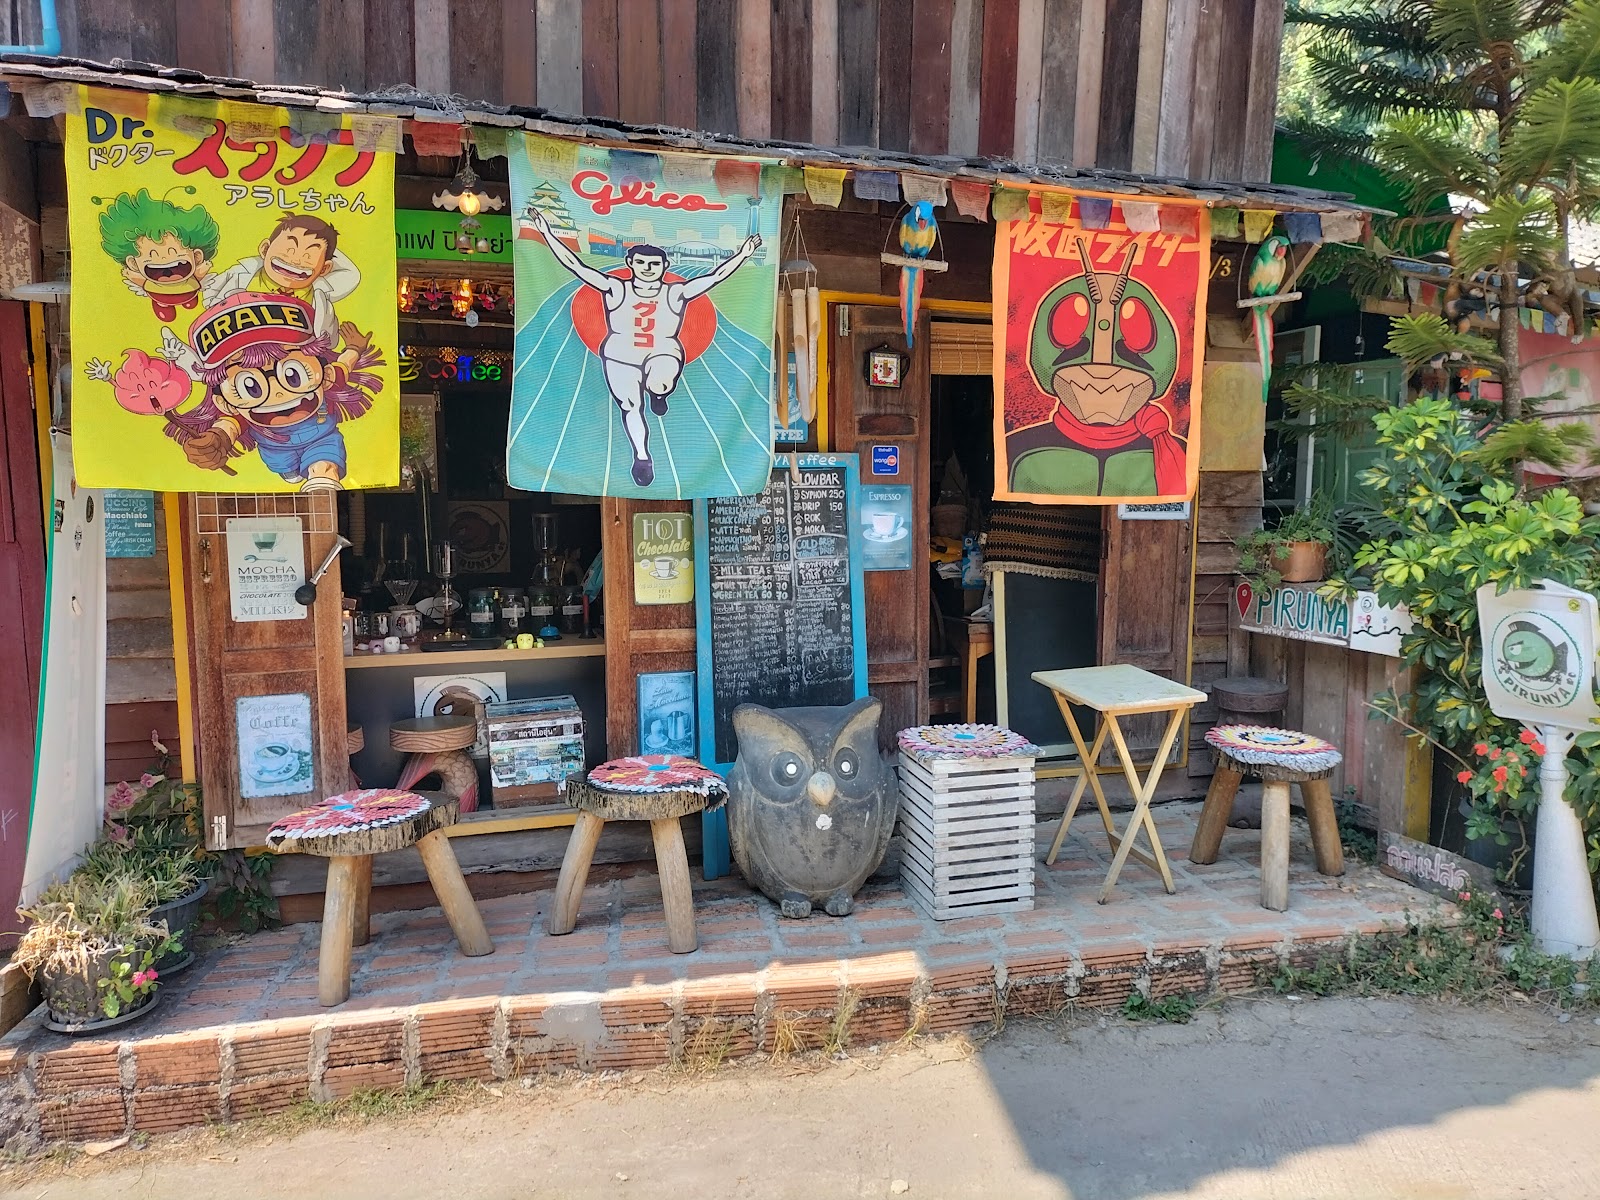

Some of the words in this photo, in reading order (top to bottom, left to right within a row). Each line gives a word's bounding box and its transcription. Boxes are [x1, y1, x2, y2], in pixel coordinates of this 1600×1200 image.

[84, 107, 154, 144] Dr.
[88, 141, 175, 170] ドクター
[571, 170, 729, 215] Glico
[201, 305, 304, 353] ARALE
[632, 301, 659, 348] グリコ
[798, 454, 836, 466] offee
[773, 496, 785, 504] 70
[801, 490, 827, 499] SYPHON
[829, 489, 845, 499] 250
[802, 501, 820, 511] DRIP
[829, 502, 843, 511] 150
[804, 513, 821, 523] ROK
[642, 518, 685, 541] HOT
[715, 526, 739, 534] LATTE
[804, 525, 825, 534] MOKA
[637, 538, 690, 556] Chocolate
[238, 566, 296, 575] MOCHA
[721, 565, 743, 576] MILK
[747, 565, 766, 575] TEA
[720, 591, 742, 599] GREEN
[744, 591, 759, 599] TEA
[1255, 587, 1350, 639] PIRUNYA
[1504, 677, 1571, 705] PIRUNYA
